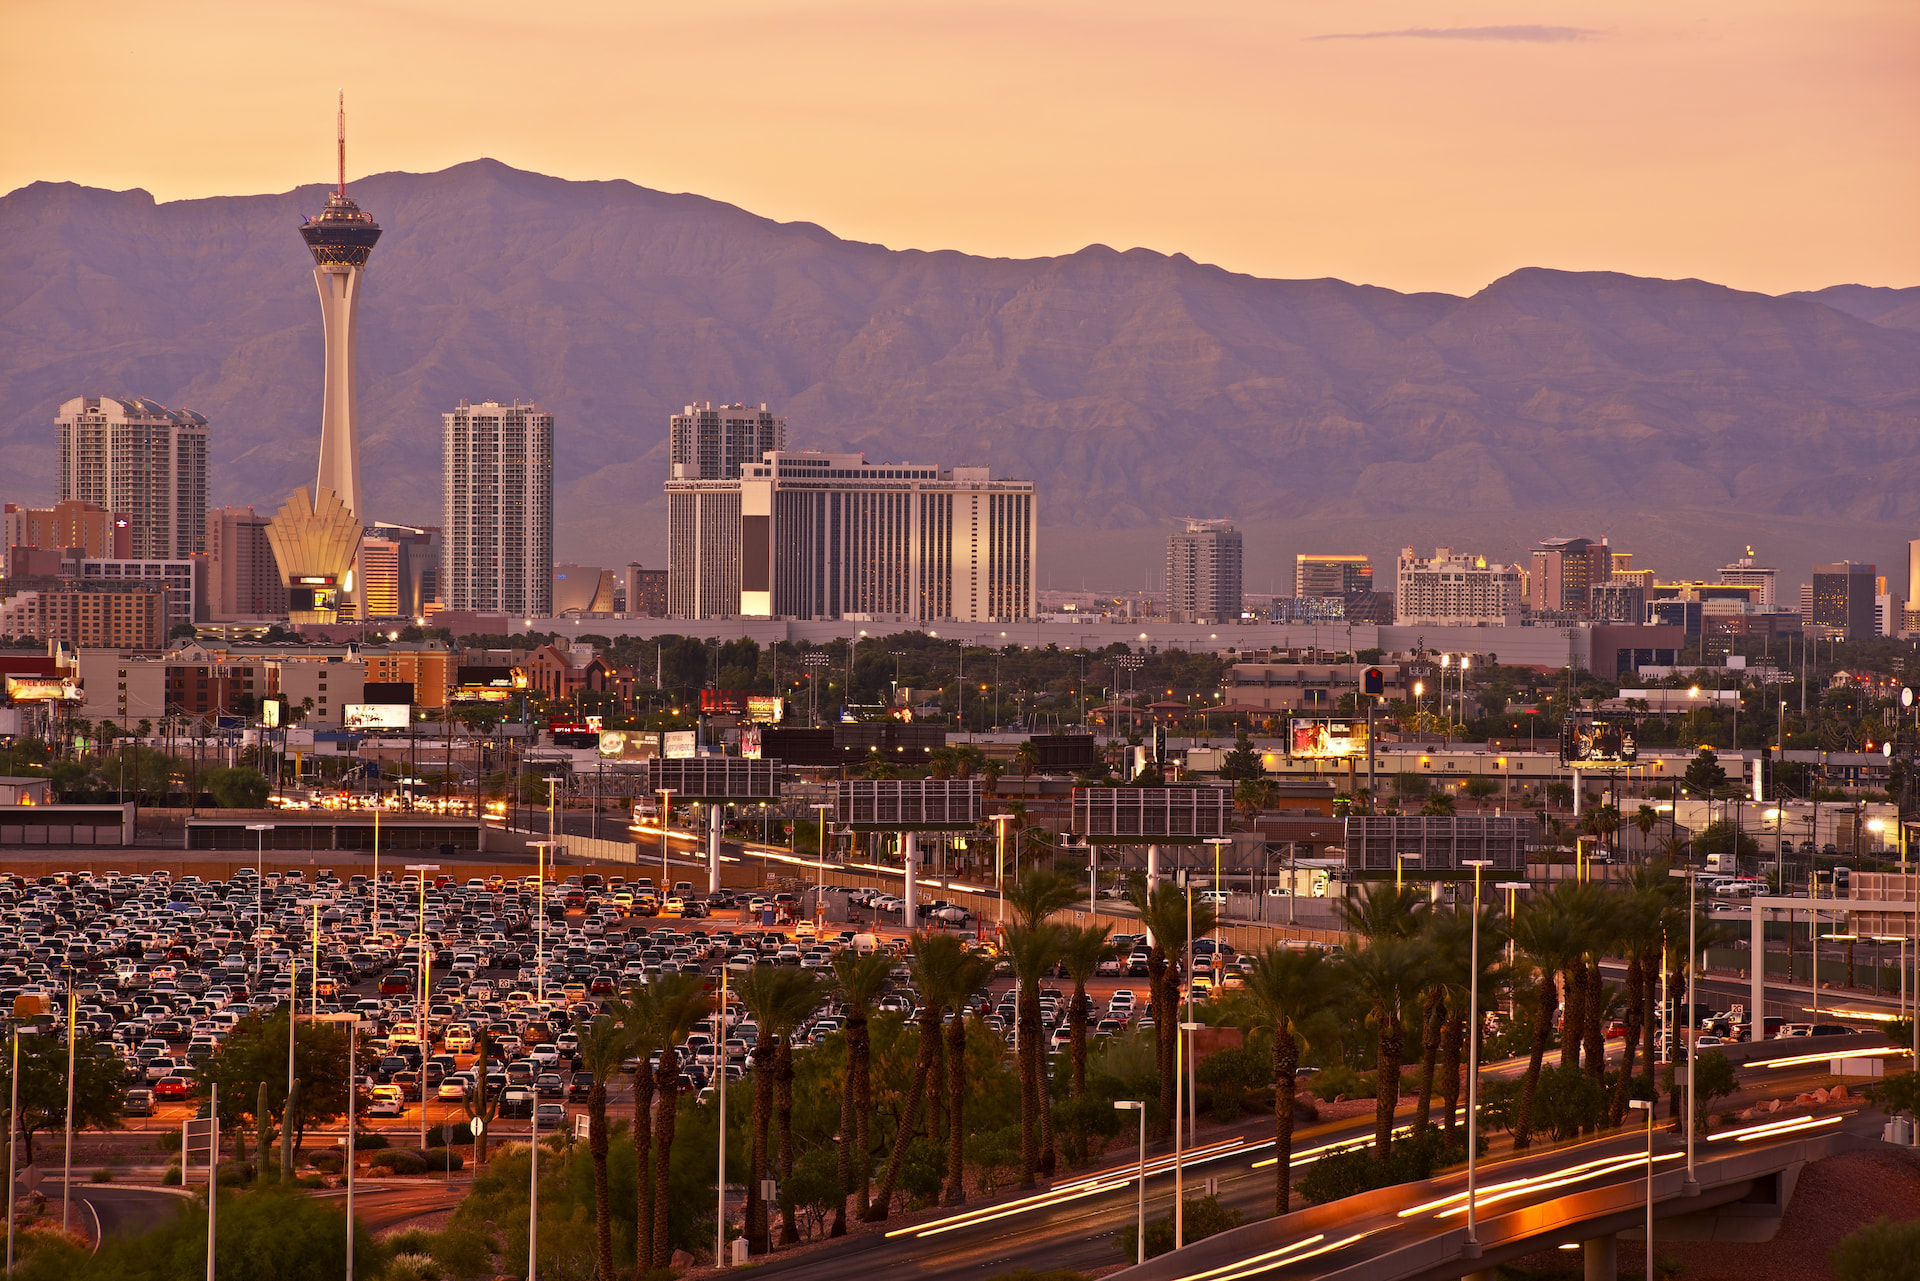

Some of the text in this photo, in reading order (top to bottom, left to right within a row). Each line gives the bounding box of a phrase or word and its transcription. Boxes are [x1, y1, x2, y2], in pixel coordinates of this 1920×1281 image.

[500, 979, 509, 987] 2G
[480, 991, 488, 999] 2F
[415, 1004, 423, 1012] 2E
[390, 1013, 399, 1021] 2D
[366, 1026, 376, 1035] 2C
[1782, 1026, 1789, 1034] 2F
